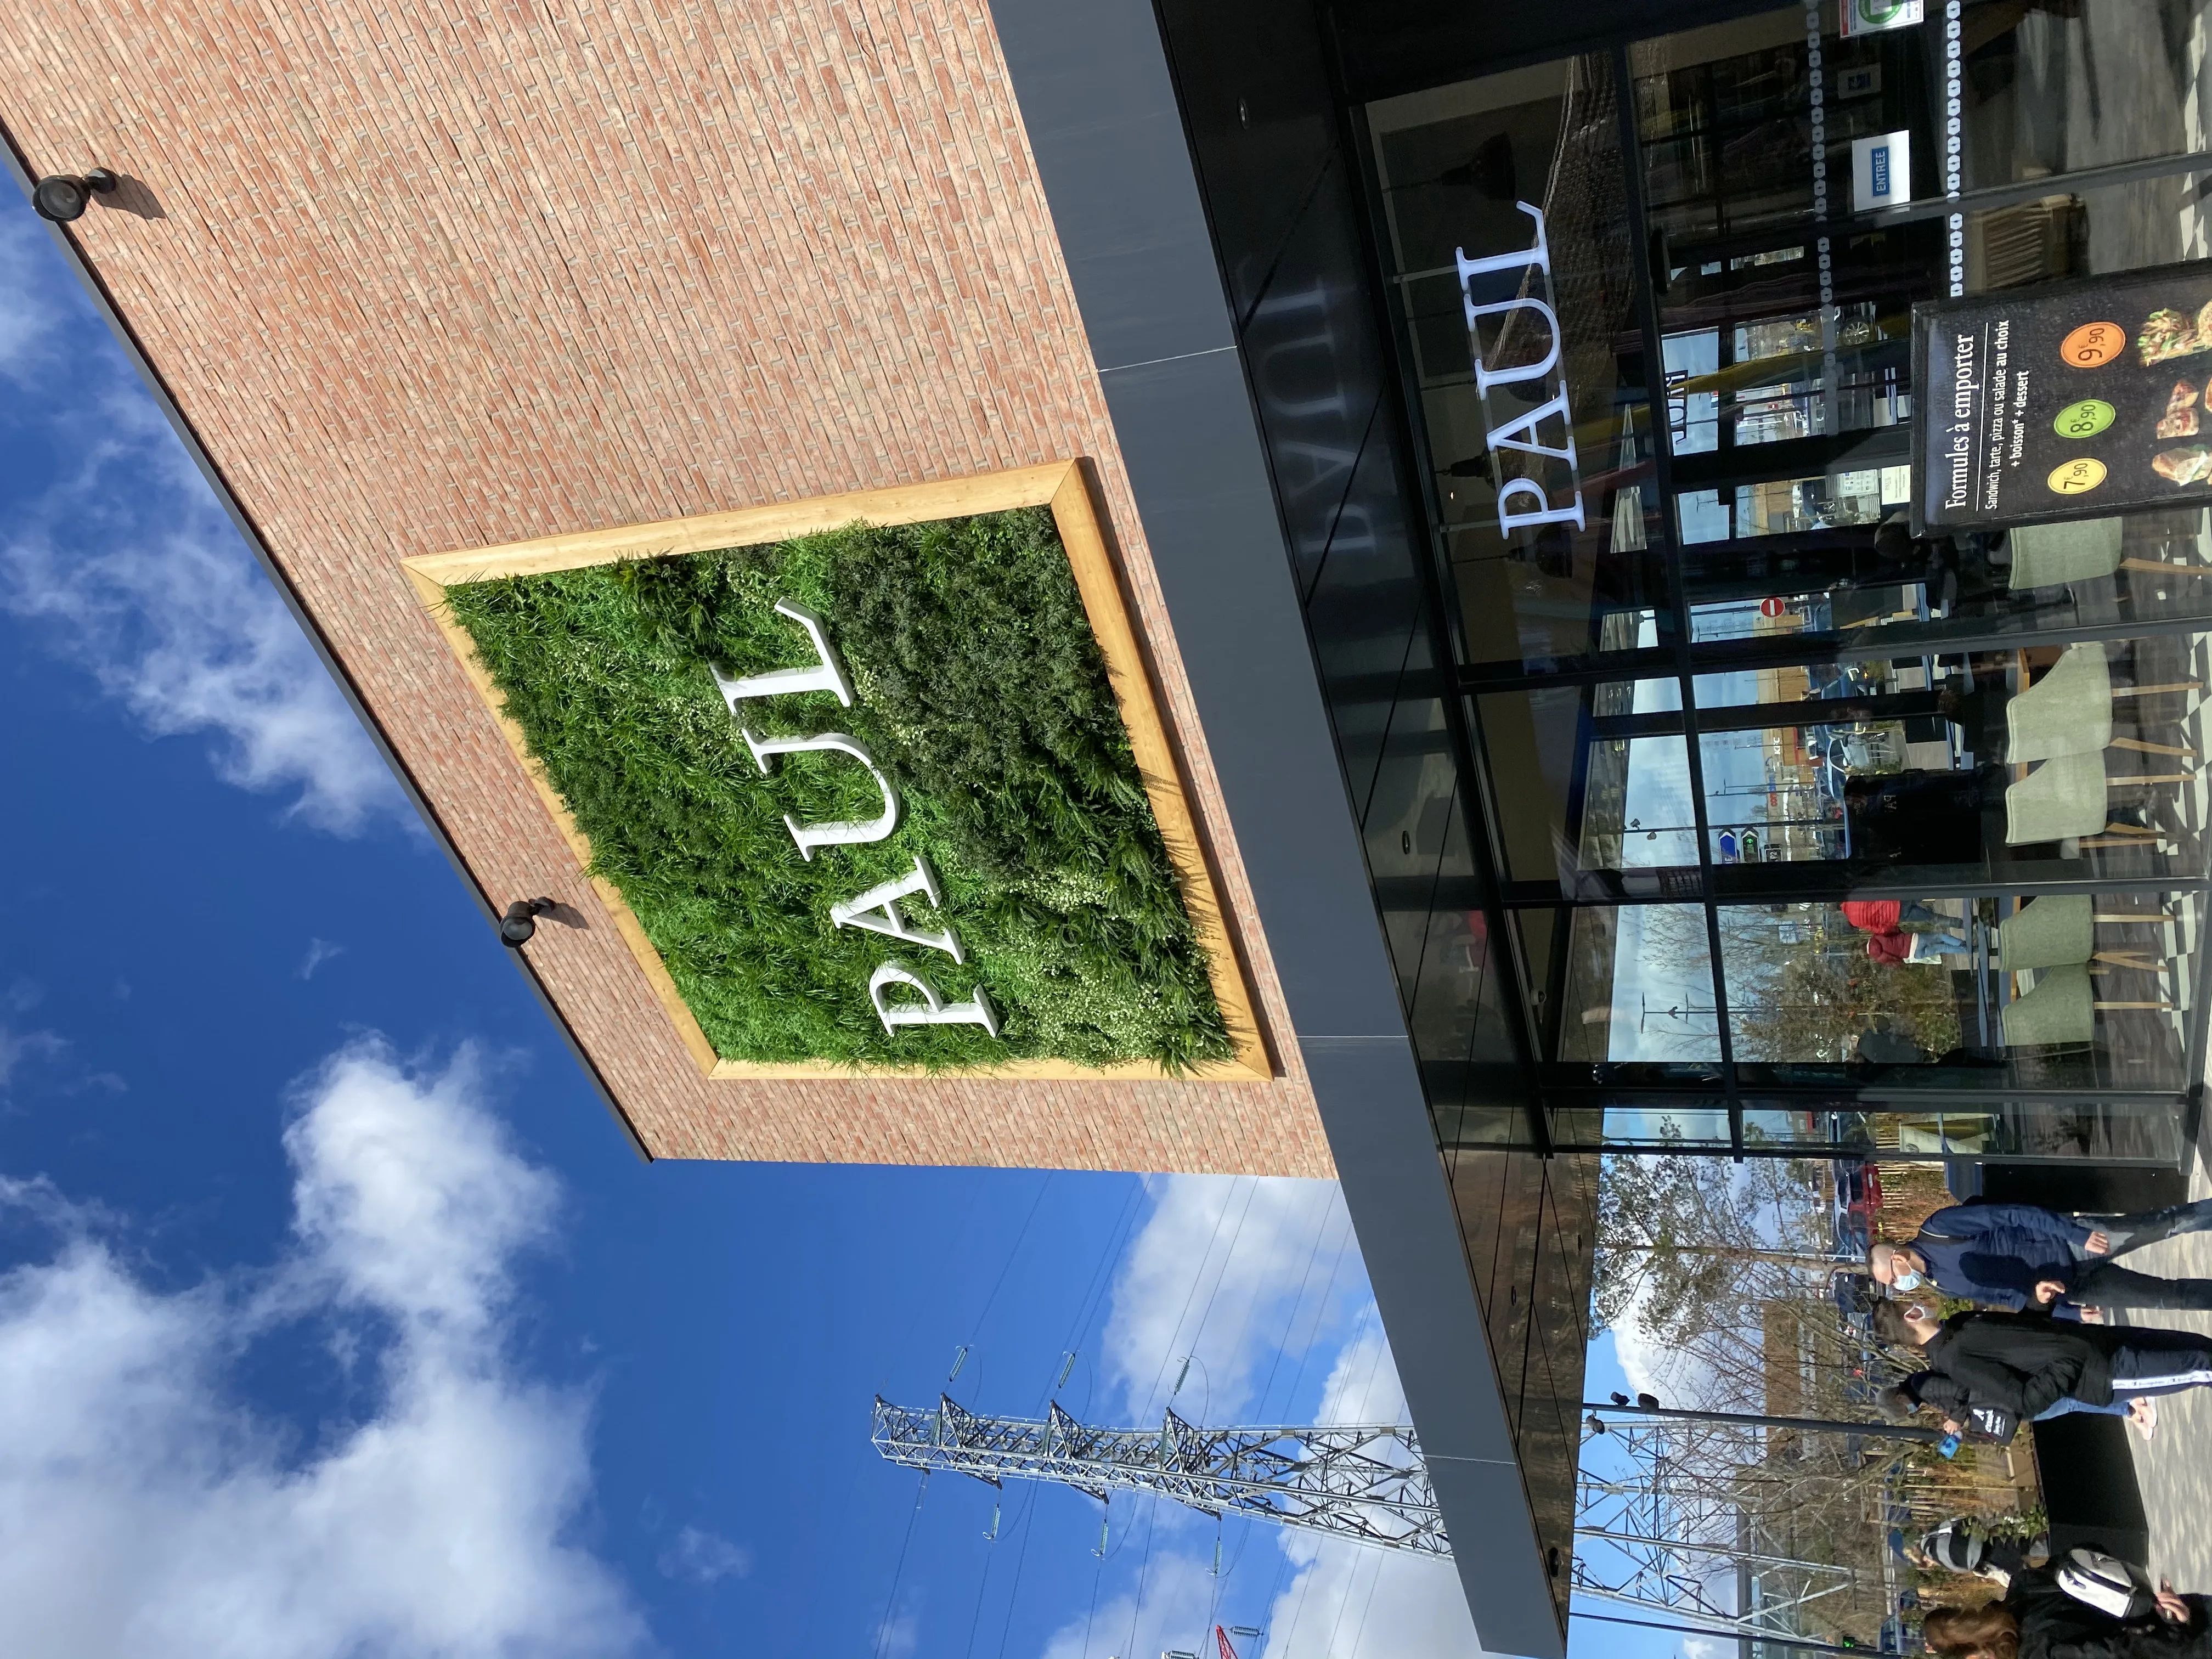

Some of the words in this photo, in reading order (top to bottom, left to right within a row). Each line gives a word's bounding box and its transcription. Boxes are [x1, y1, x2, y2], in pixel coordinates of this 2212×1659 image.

[1875, 151, 1886, 191] ENTREE
[1994, 320, 2009, 349] choix
[1455, 201, 1585, 539] PAUL
[1954, 334, 1979, 418] emporter
[1996, 352, 2007, 366] au
[1992, 369, 2006, 401] salade
[2013, 370, 2029, 408] dessert
[1994, 403, 2004, 415] ou
[1946, 422, 1970, 432] à
[1989, 417, 2005, 441] pizza
[1989, 443, 2004, 467] tarte,
[1945, 436, 1970, 510] Formules
[1985, 470, 2001, 510] Sandwich,
[709, 596, 1000, 1037] PAUL
